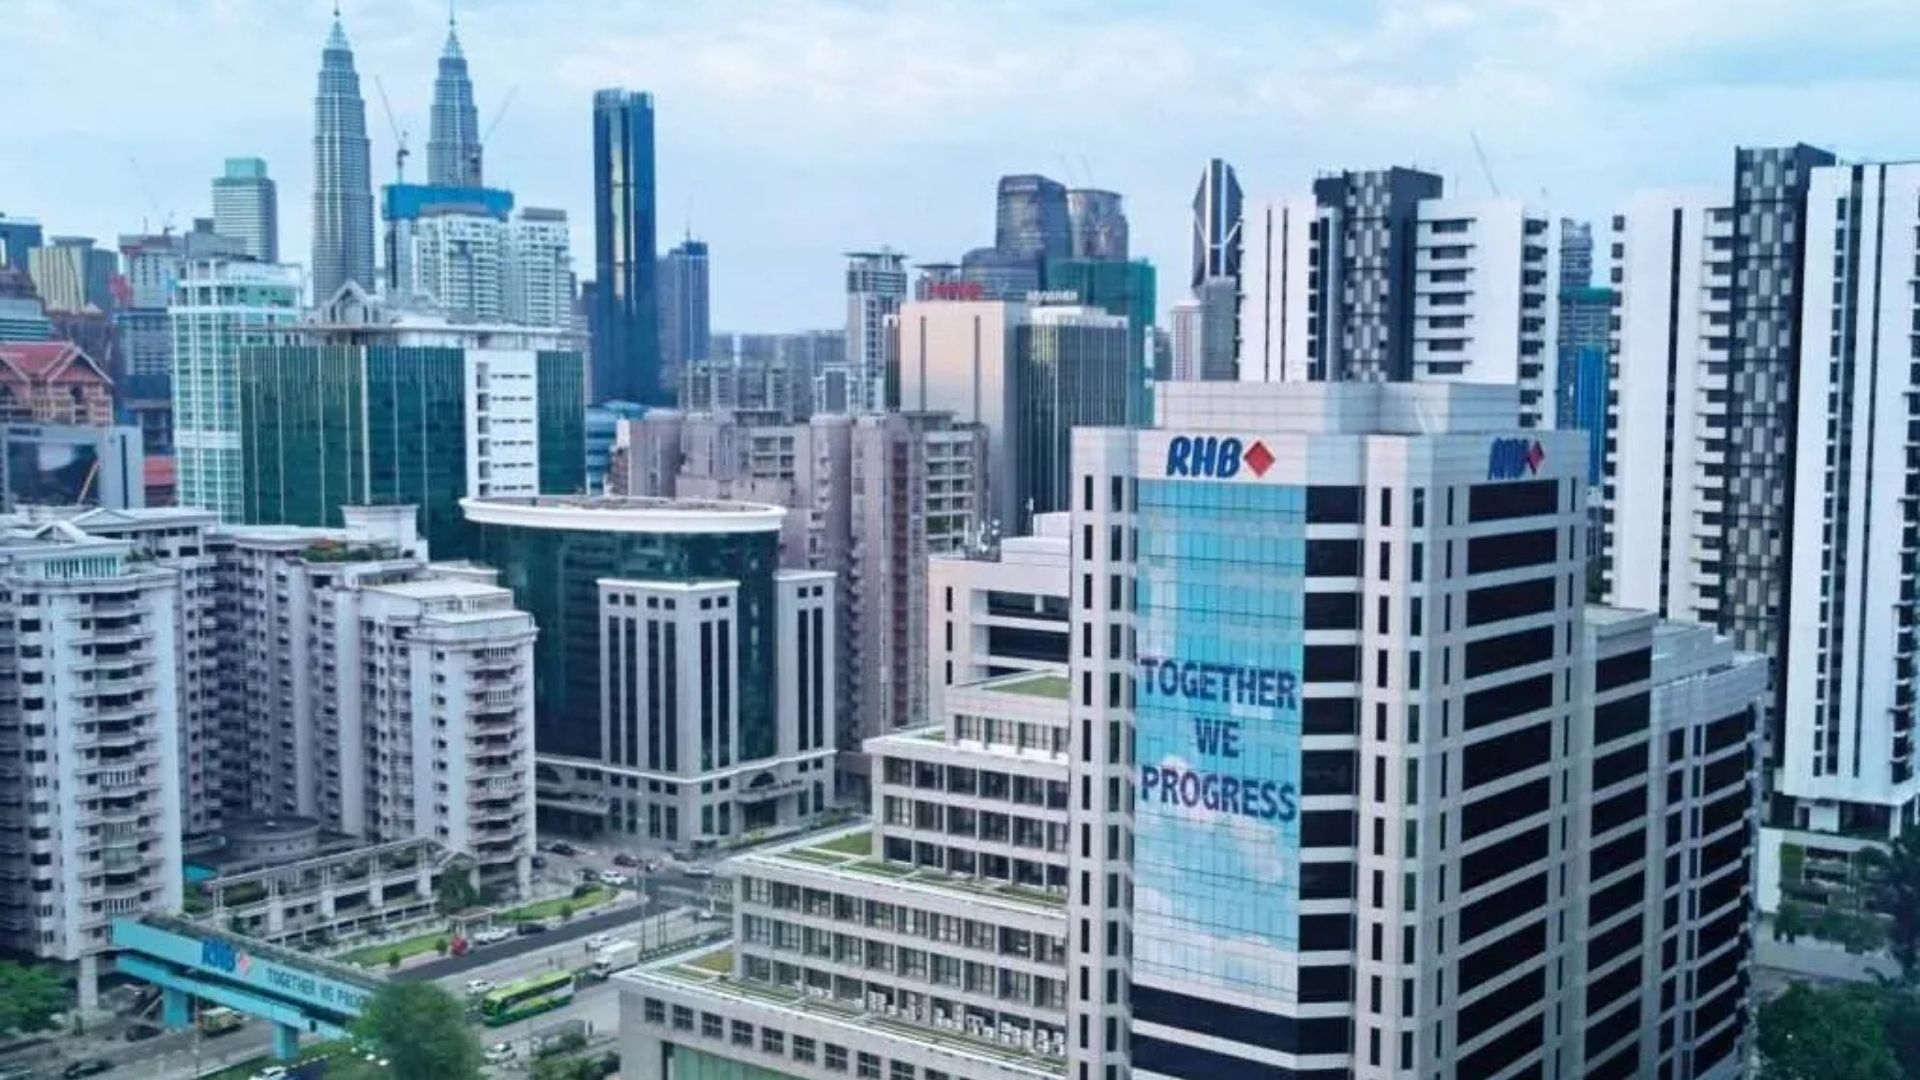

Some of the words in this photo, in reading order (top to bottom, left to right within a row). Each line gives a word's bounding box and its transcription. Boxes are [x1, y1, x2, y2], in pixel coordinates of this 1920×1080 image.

[1166, 436, 1243, 478] RHB
[1139, 658, 1296, 710] TOGETHER
[1195, 717, 1240, 758] WE
[1141, 765, 1296, 822] PROGRESS
[267, 967, 316, 995] TOGETHER
[320, 983, 335, 1002] WE
